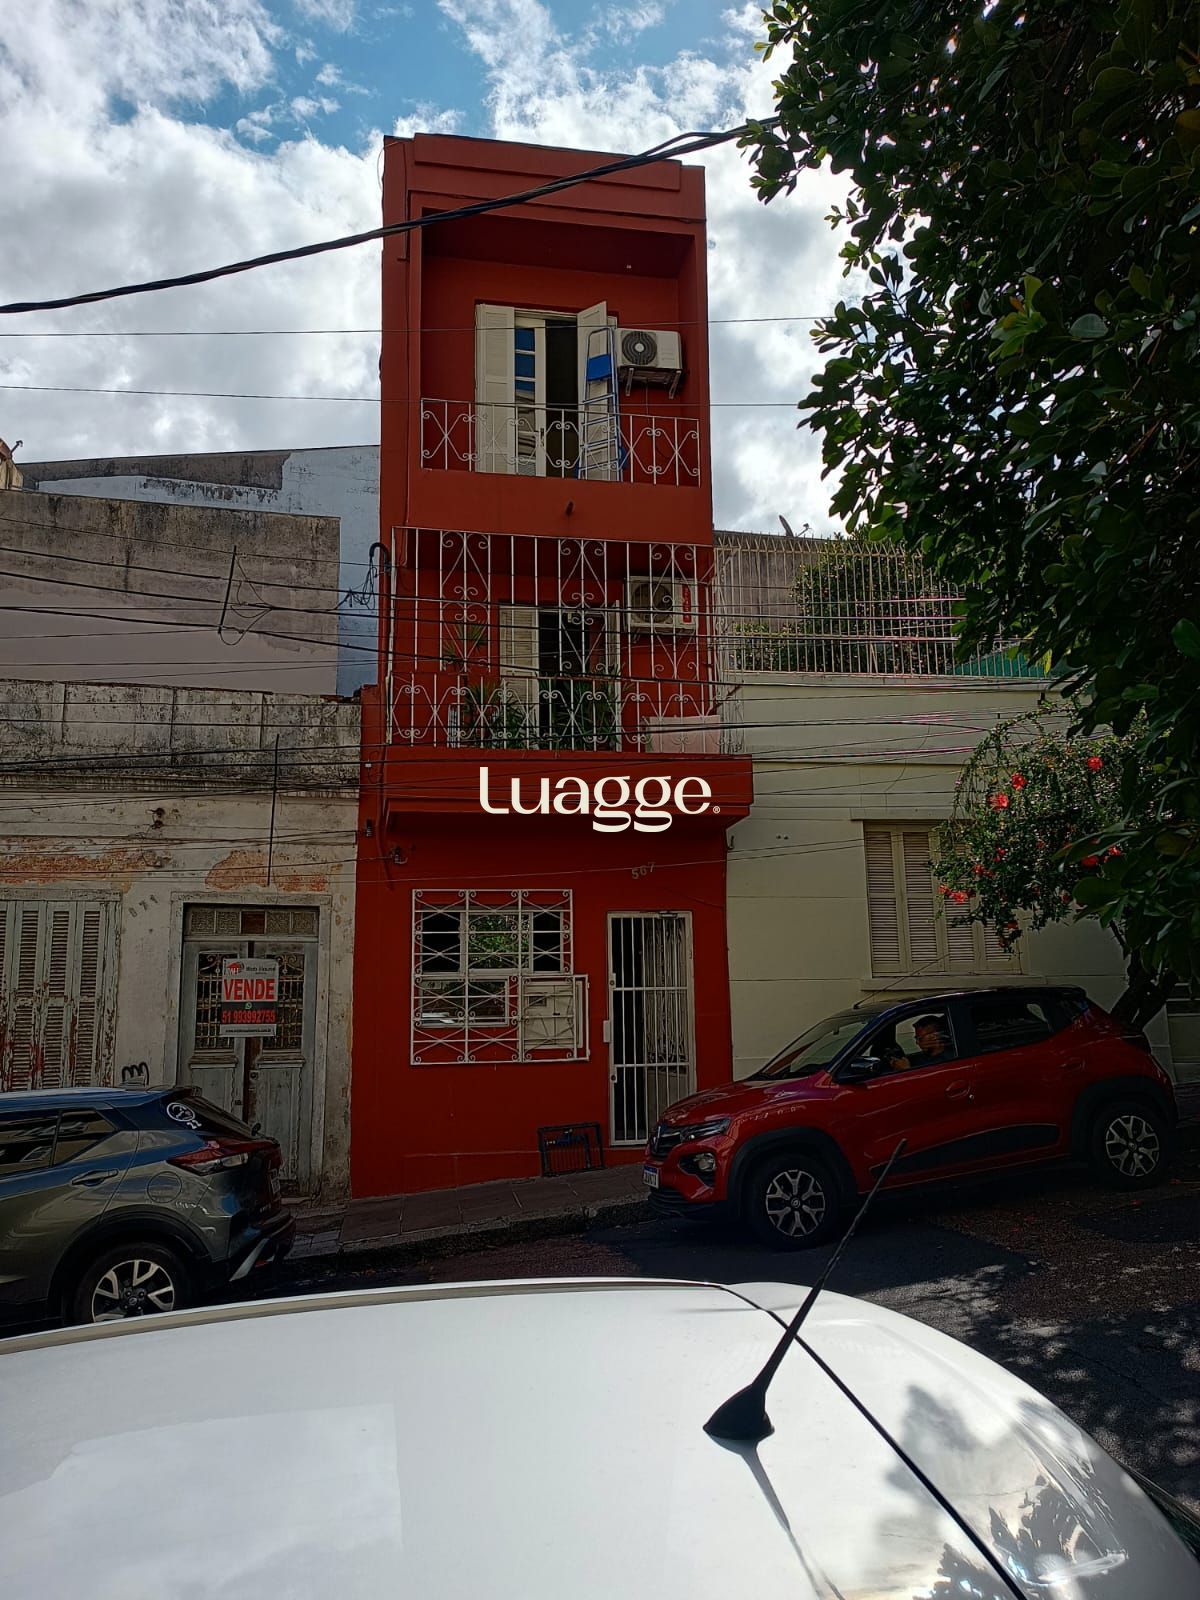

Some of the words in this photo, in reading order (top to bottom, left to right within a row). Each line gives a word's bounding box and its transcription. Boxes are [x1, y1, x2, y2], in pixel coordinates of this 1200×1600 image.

[631, 861, 657, 880] 567
[223, 978, 276, 1001] VENDE
[221, 1010, 232, 1024] 51
